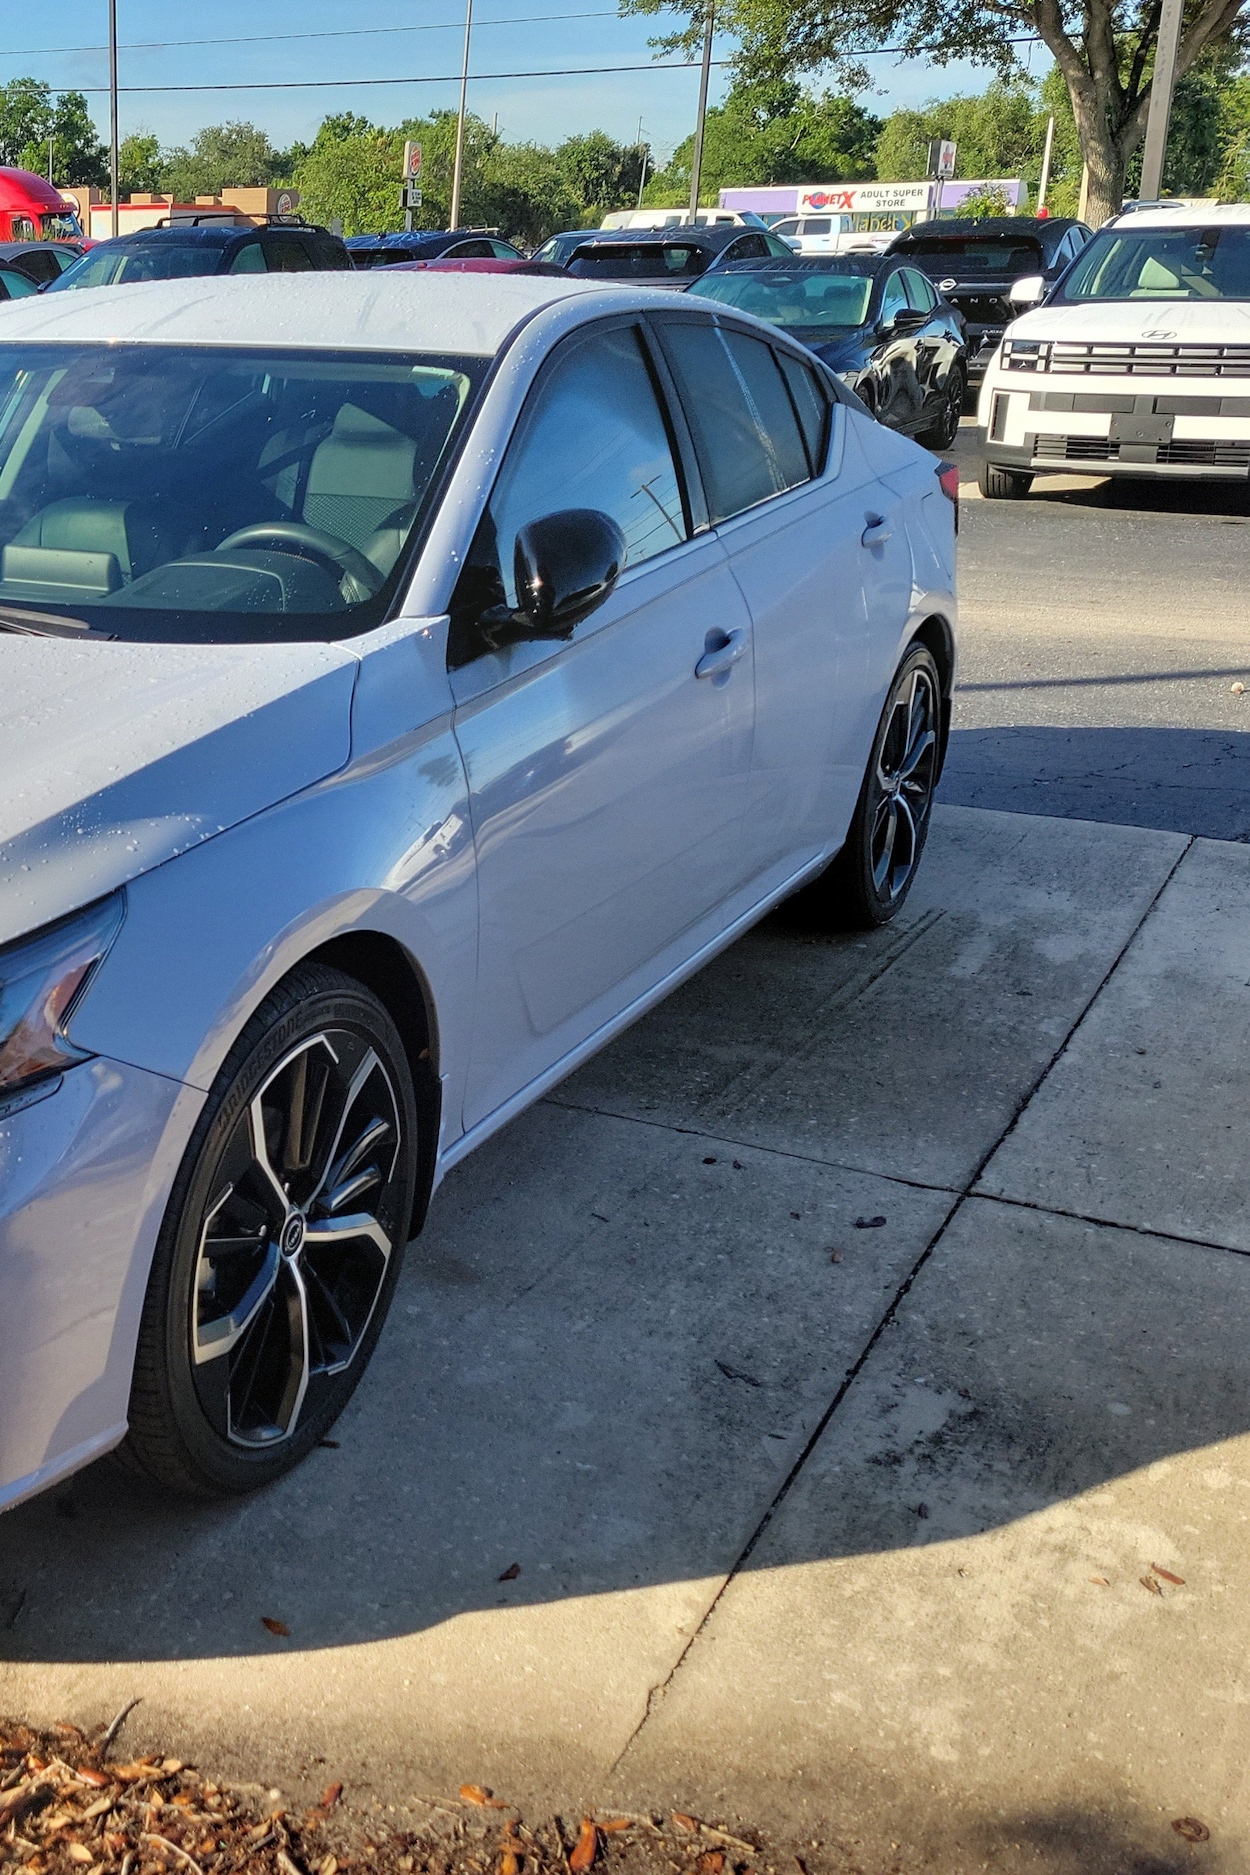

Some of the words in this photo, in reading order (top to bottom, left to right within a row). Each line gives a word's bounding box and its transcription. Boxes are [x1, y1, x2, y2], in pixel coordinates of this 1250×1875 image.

[860, 190, 890, 199] ADULT
[892, 188, 924, 198] SUPER
[875, 199, 906, 208] STORE
